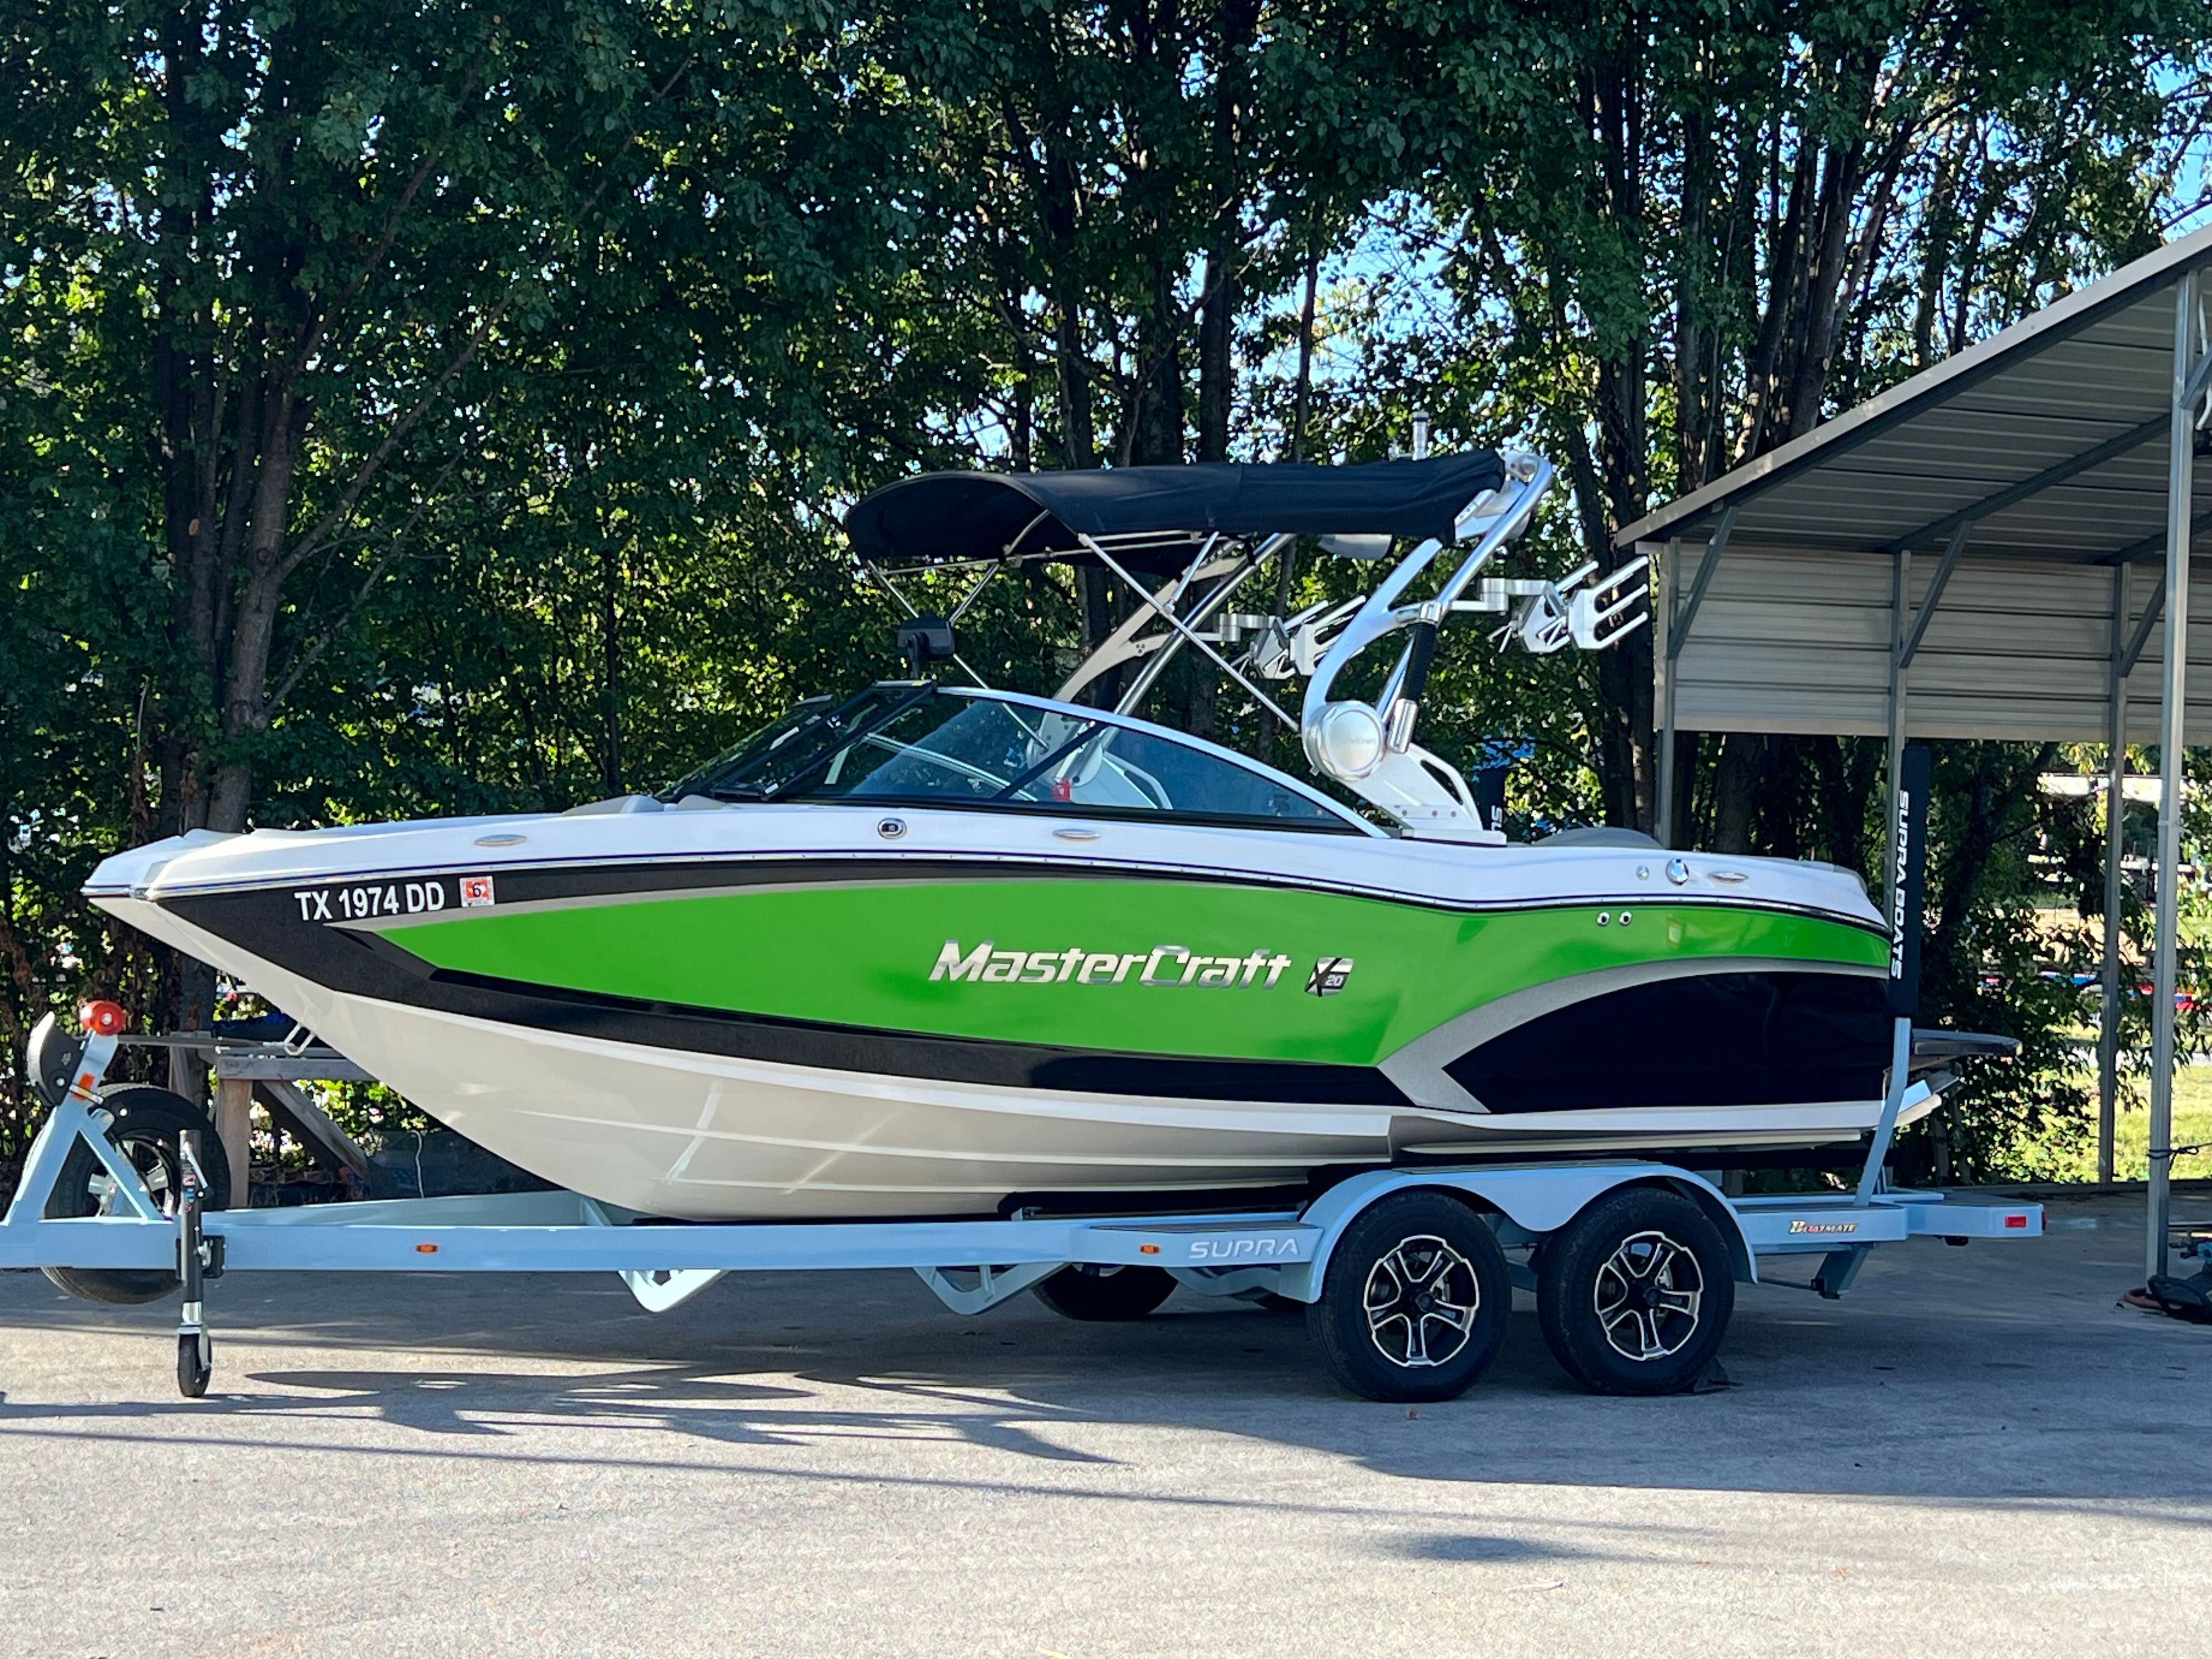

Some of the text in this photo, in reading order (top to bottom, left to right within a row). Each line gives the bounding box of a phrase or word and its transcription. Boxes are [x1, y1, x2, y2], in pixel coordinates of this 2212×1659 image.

[294, 881, 445, 921] TX 1974 DD
[1892, 790, 1909, 979] SUPRA BOATS
[928, 939, 1291, 990] MasterCraft
[1188, 1238, 1299, 1259] SUPRA
